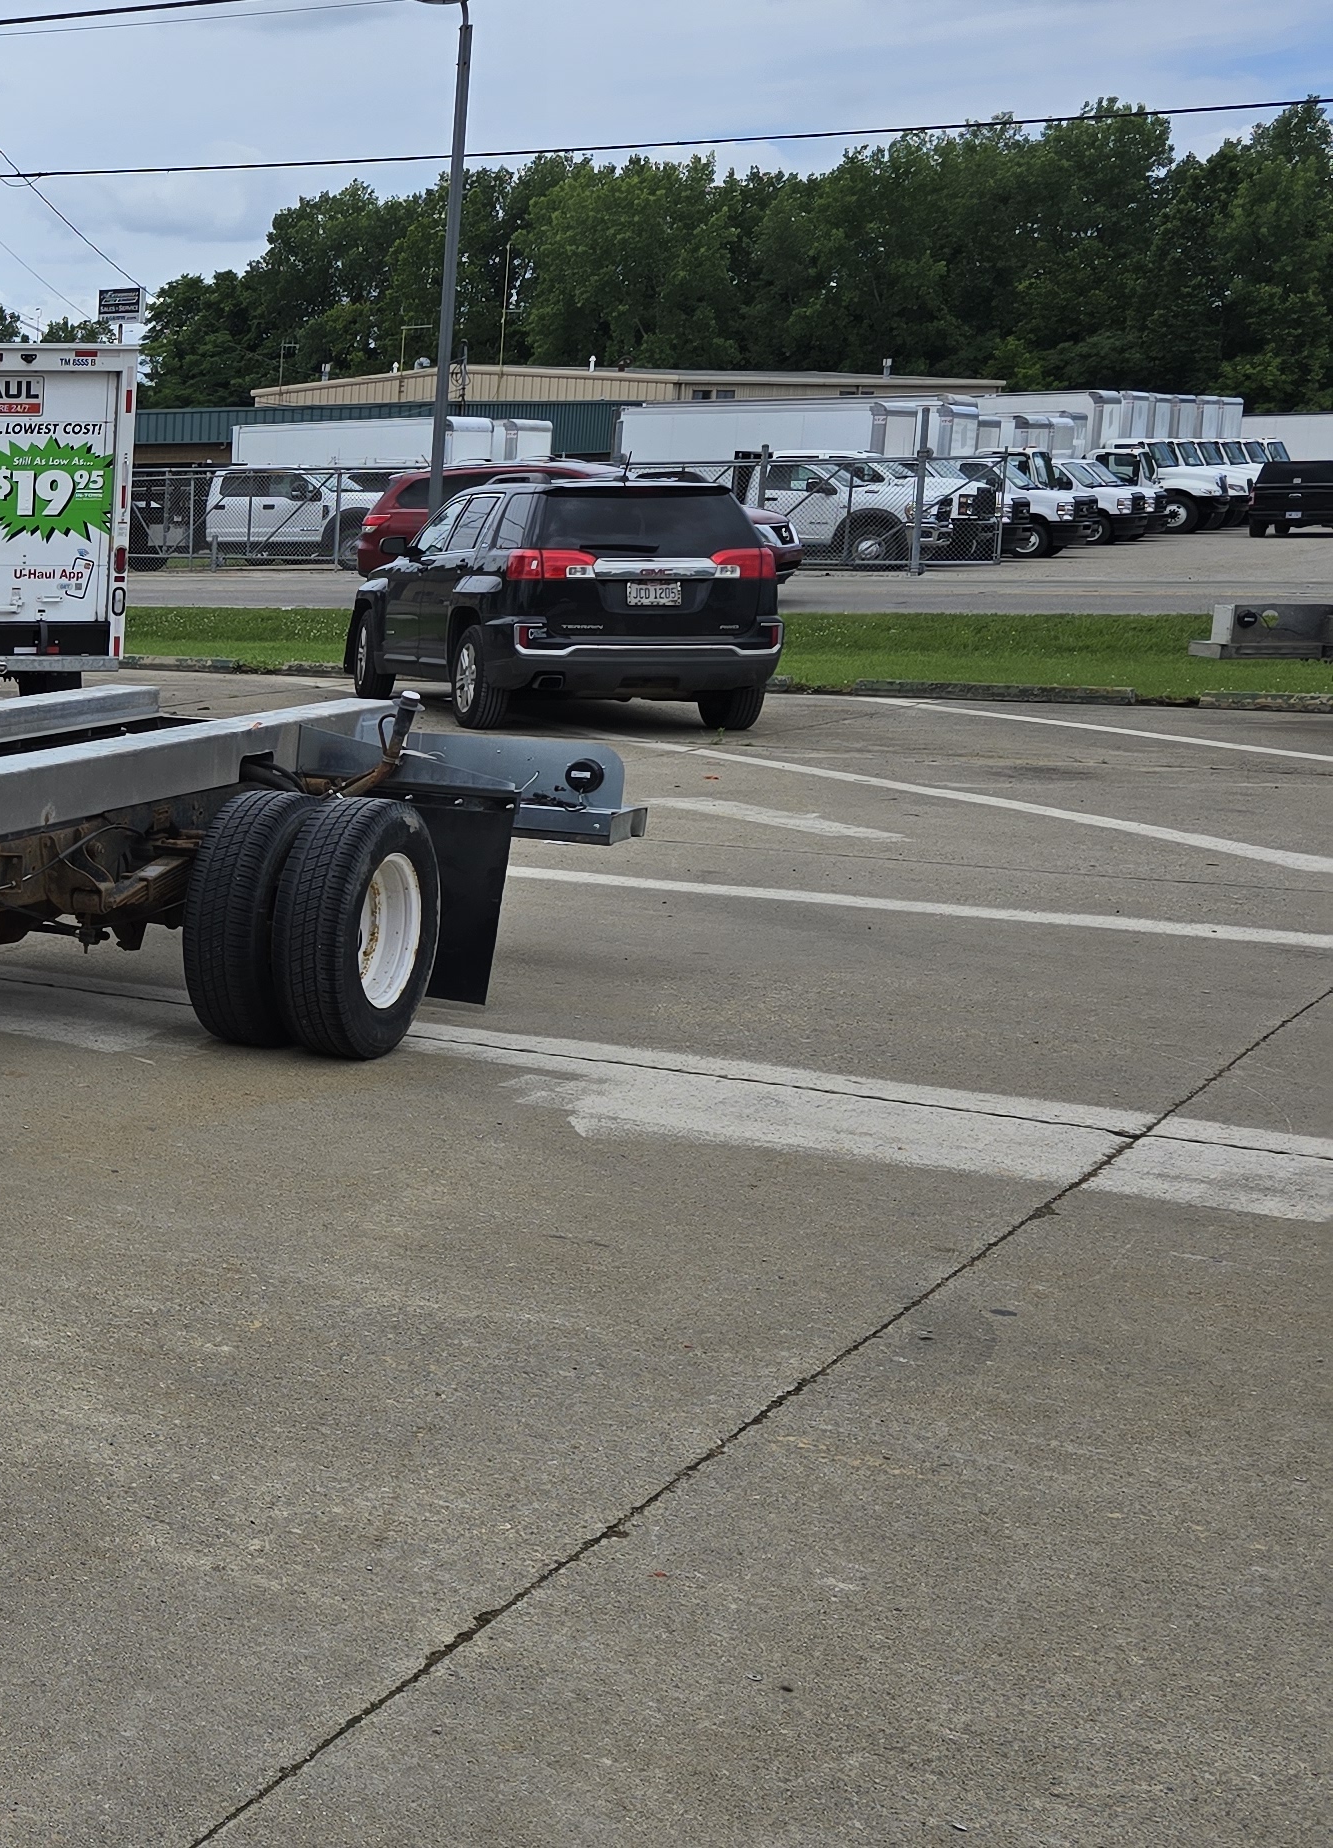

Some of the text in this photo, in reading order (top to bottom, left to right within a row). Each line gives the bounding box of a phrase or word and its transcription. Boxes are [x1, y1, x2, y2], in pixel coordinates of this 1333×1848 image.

[59, 357, 71, 367] TM
[10, 404, 30, 413] 24/7
[62, 422, 103, 435] COST!
[13, 456, 94, 466] Still As Low As...
[13, 568, 84, 581] U-Haul App
[639, 568, 674, 577] GMC
[632, 586, 677, 600] JCD 1205
